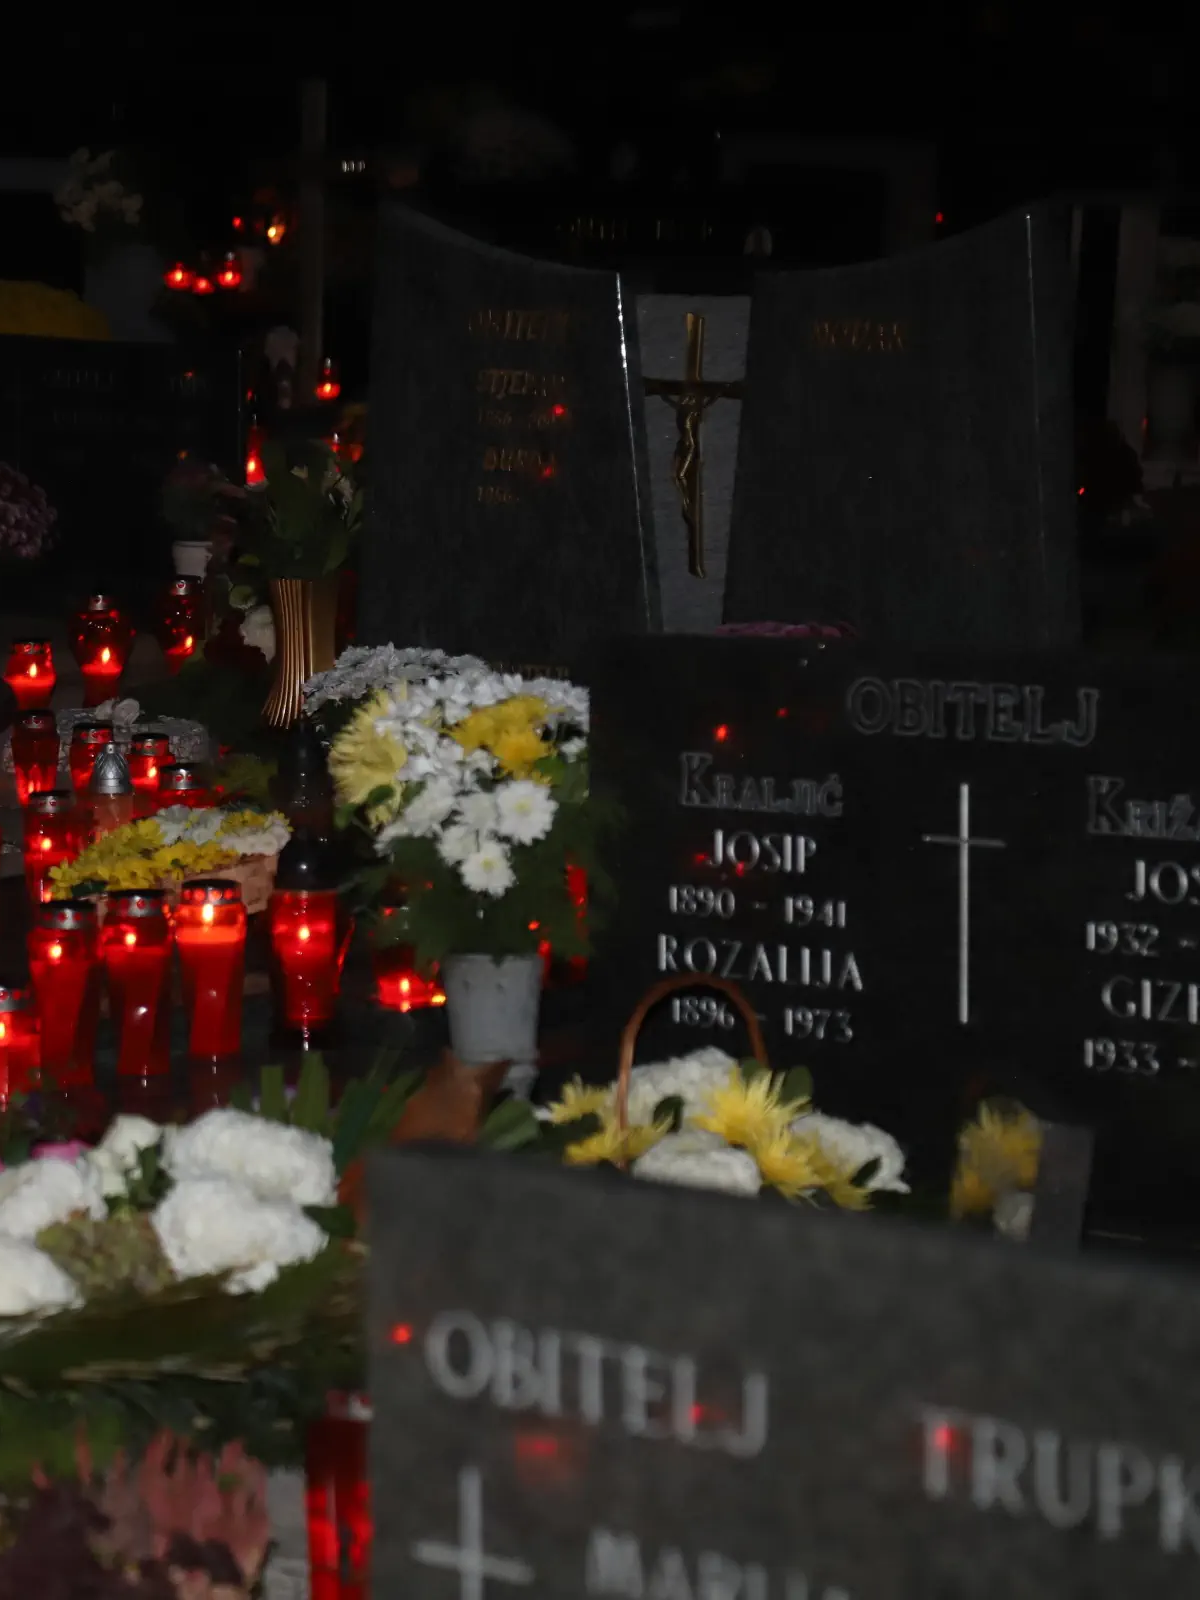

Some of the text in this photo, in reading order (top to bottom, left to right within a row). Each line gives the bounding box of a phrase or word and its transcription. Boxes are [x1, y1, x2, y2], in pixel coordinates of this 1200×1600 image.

[845, 676, 1099, 747] OBITELJ
[1087, 775, 1200, 842] KRIŽ
[705, 828, 817, 876] JOSIP
[668, 884, 736, 921] 1890
[783, 893, 847, 929] 1941
[656, 932, 864, 992] ROZALIJA
[1085, 920, 1160, 957] 1932
[669, 996, 736, 1031] 1896
[783, 1005, 854, 1043] 1973
[1083, 1038, 1160, 1076] 1933
[425, 1308, 768, 1460] OBITELJ
[910, 1402, 1200, 1555] TRUPK
